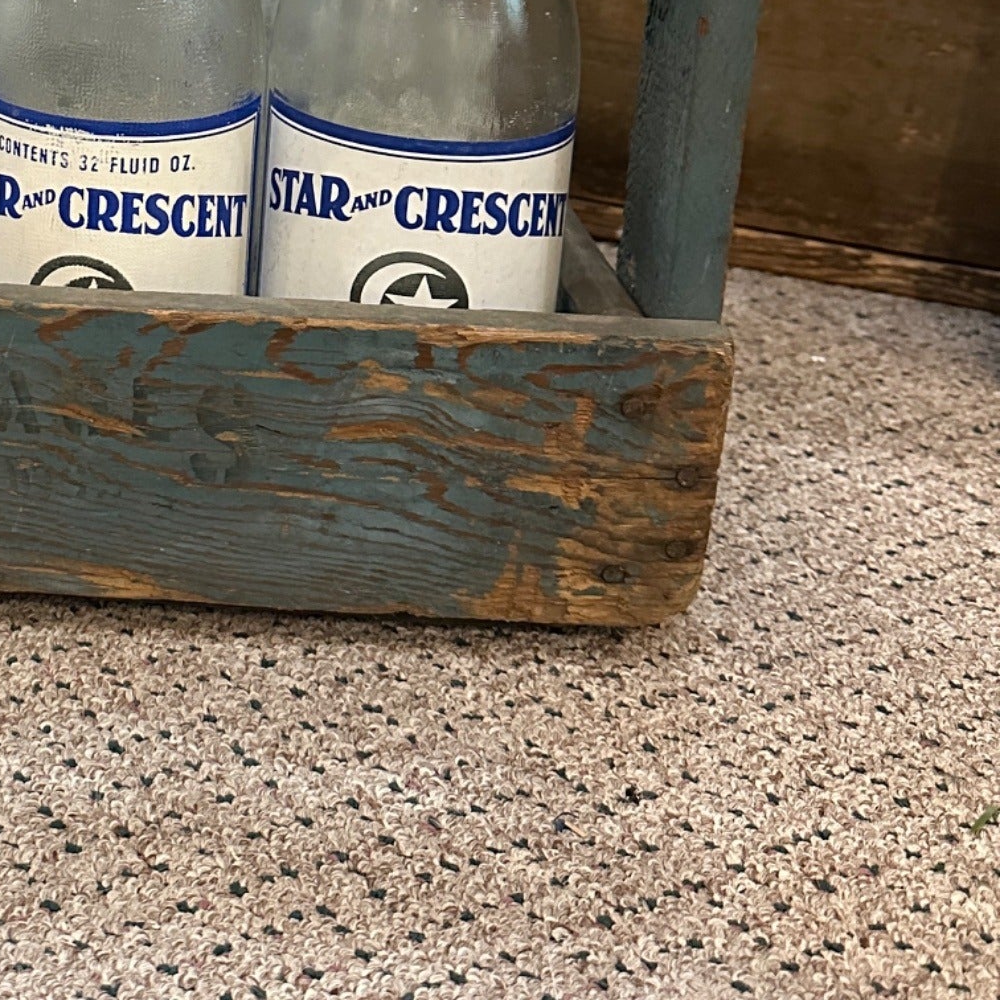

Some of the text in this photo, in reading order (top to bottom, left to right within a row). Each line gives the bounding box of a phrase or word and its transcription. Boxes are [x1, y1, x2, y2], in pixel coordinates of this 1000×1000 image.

[79, 154, 99, 172] 32
[110, 156, 159, 175] FLUID
[170, 154, 196, 173] OZ.
[22, 188, 56, 211] AND
[58, 185, 247, 238] CRESCENT
[269, 167, 565, 238] STAR AND CRESCENT
